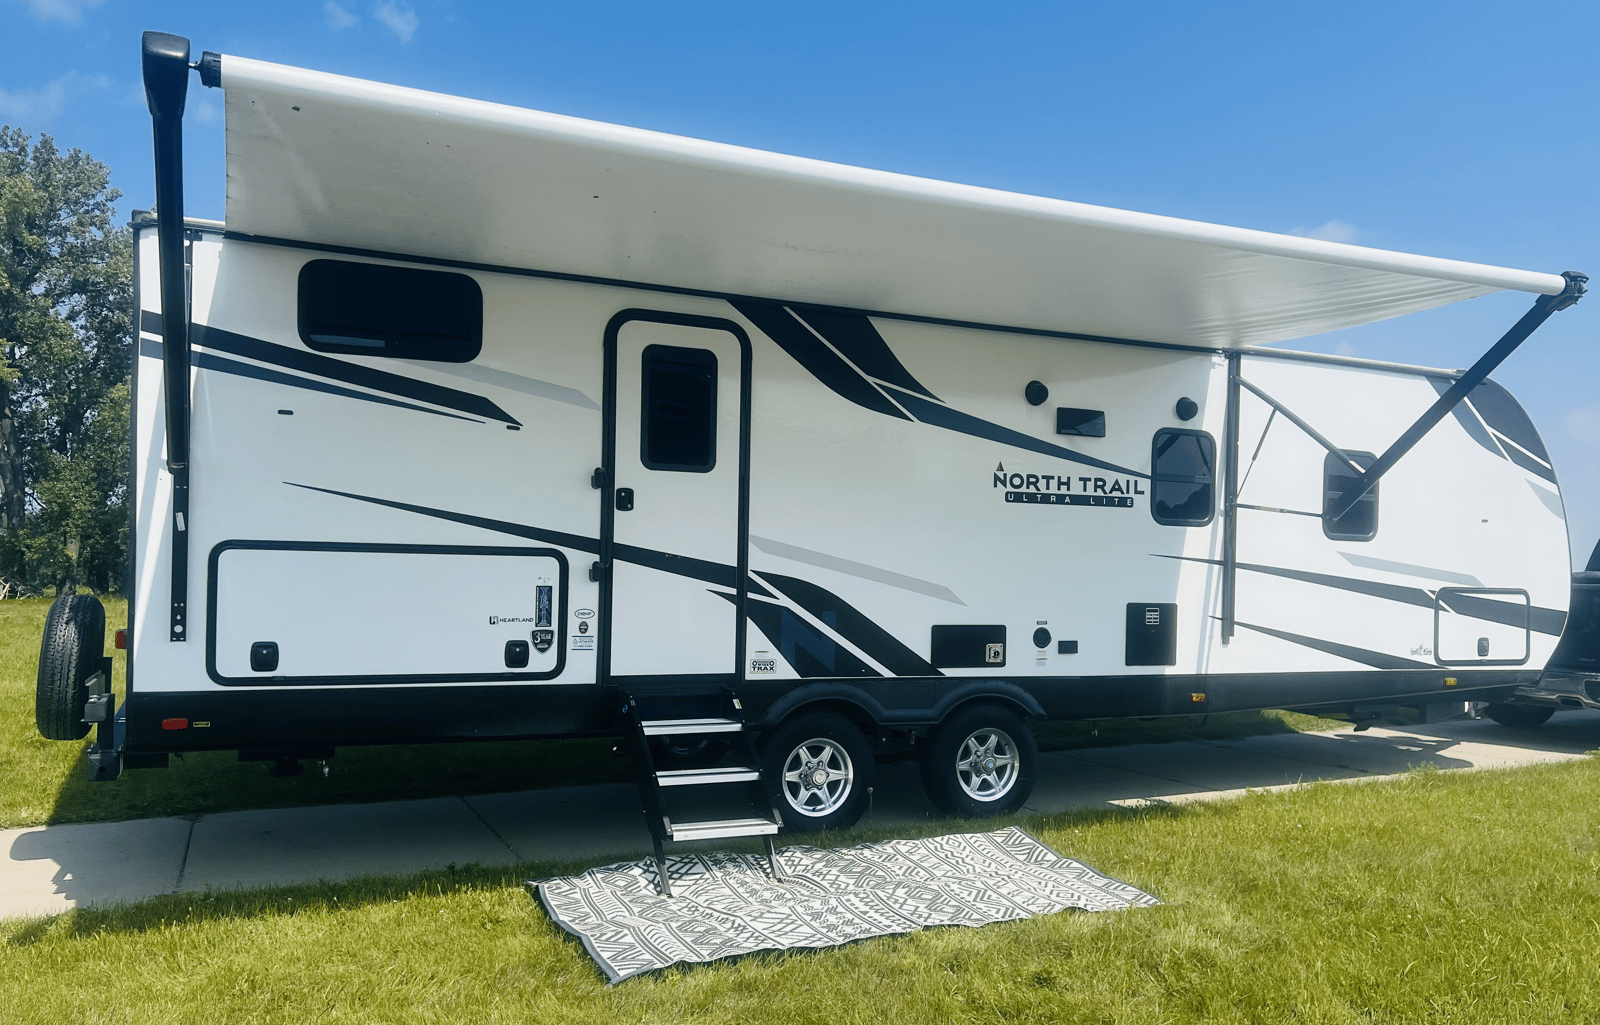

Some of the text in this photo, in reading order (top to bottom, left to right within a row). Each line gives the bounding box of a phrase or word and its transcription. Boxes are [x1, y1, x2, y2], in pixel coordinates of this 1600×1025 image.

[993, 471, 1145, 496] NORTH TRAIL
[1007, 493, 1132, 506] ULTRA LITE
[534, 631, 541, 643] 3
